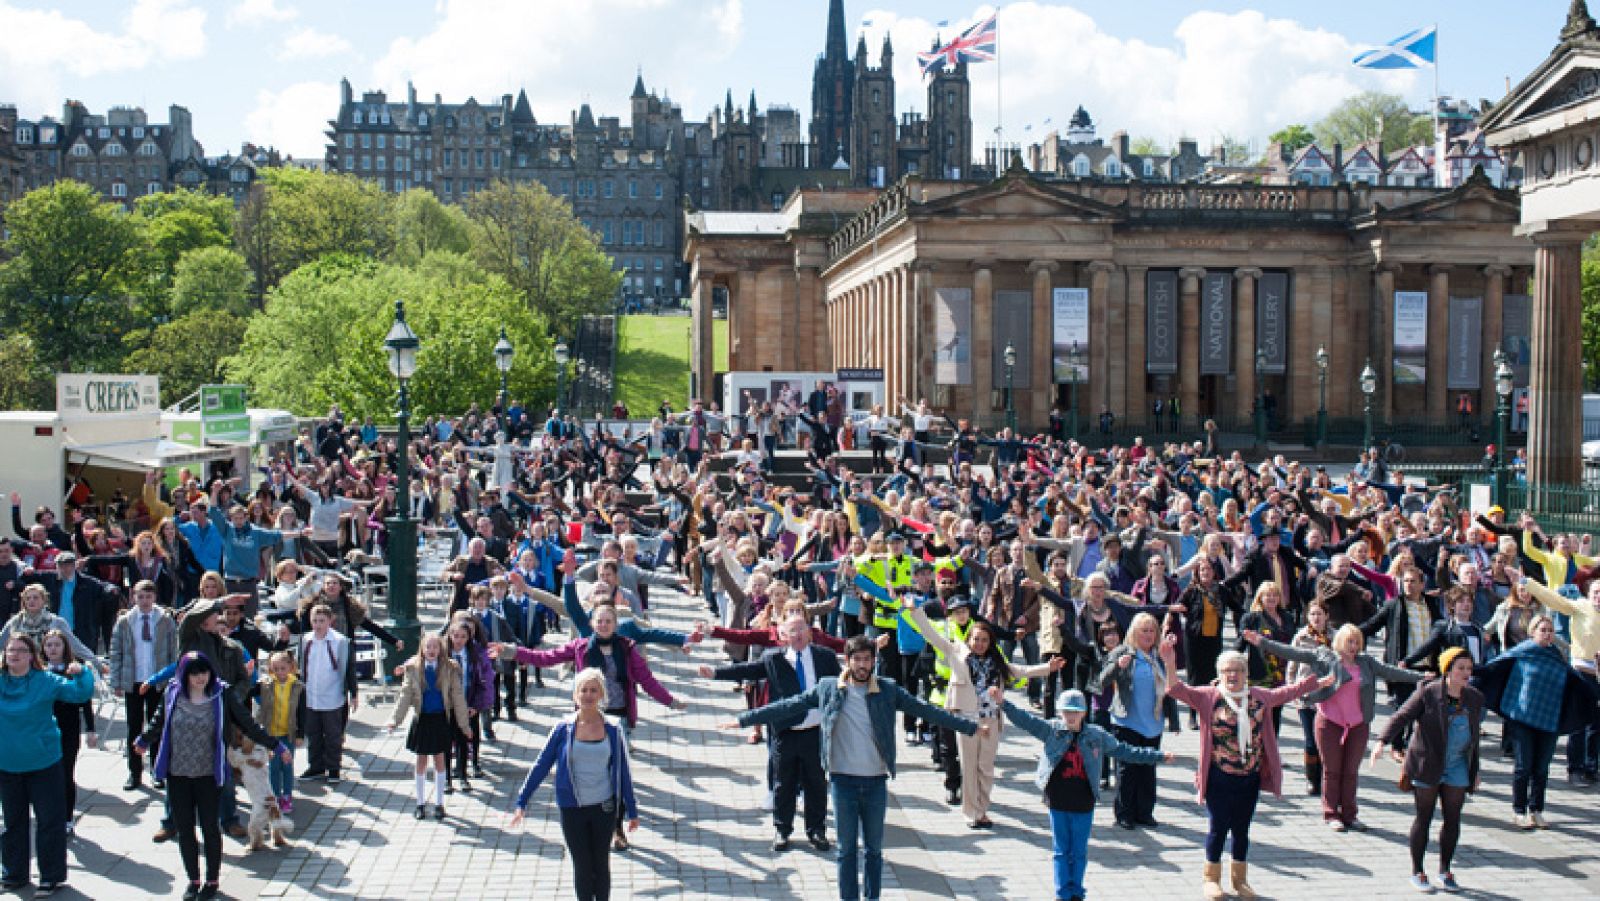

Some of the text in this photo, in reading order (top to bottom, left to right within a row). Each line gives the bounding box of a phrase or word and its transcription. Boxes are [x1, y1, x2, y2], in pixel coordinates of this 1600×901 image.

[1155, 281, 1168, 358] SCOTTISH
[1210, 276, 1224, 360] NATIONAL
[1265, 293, 1279, 359] GALLERY
